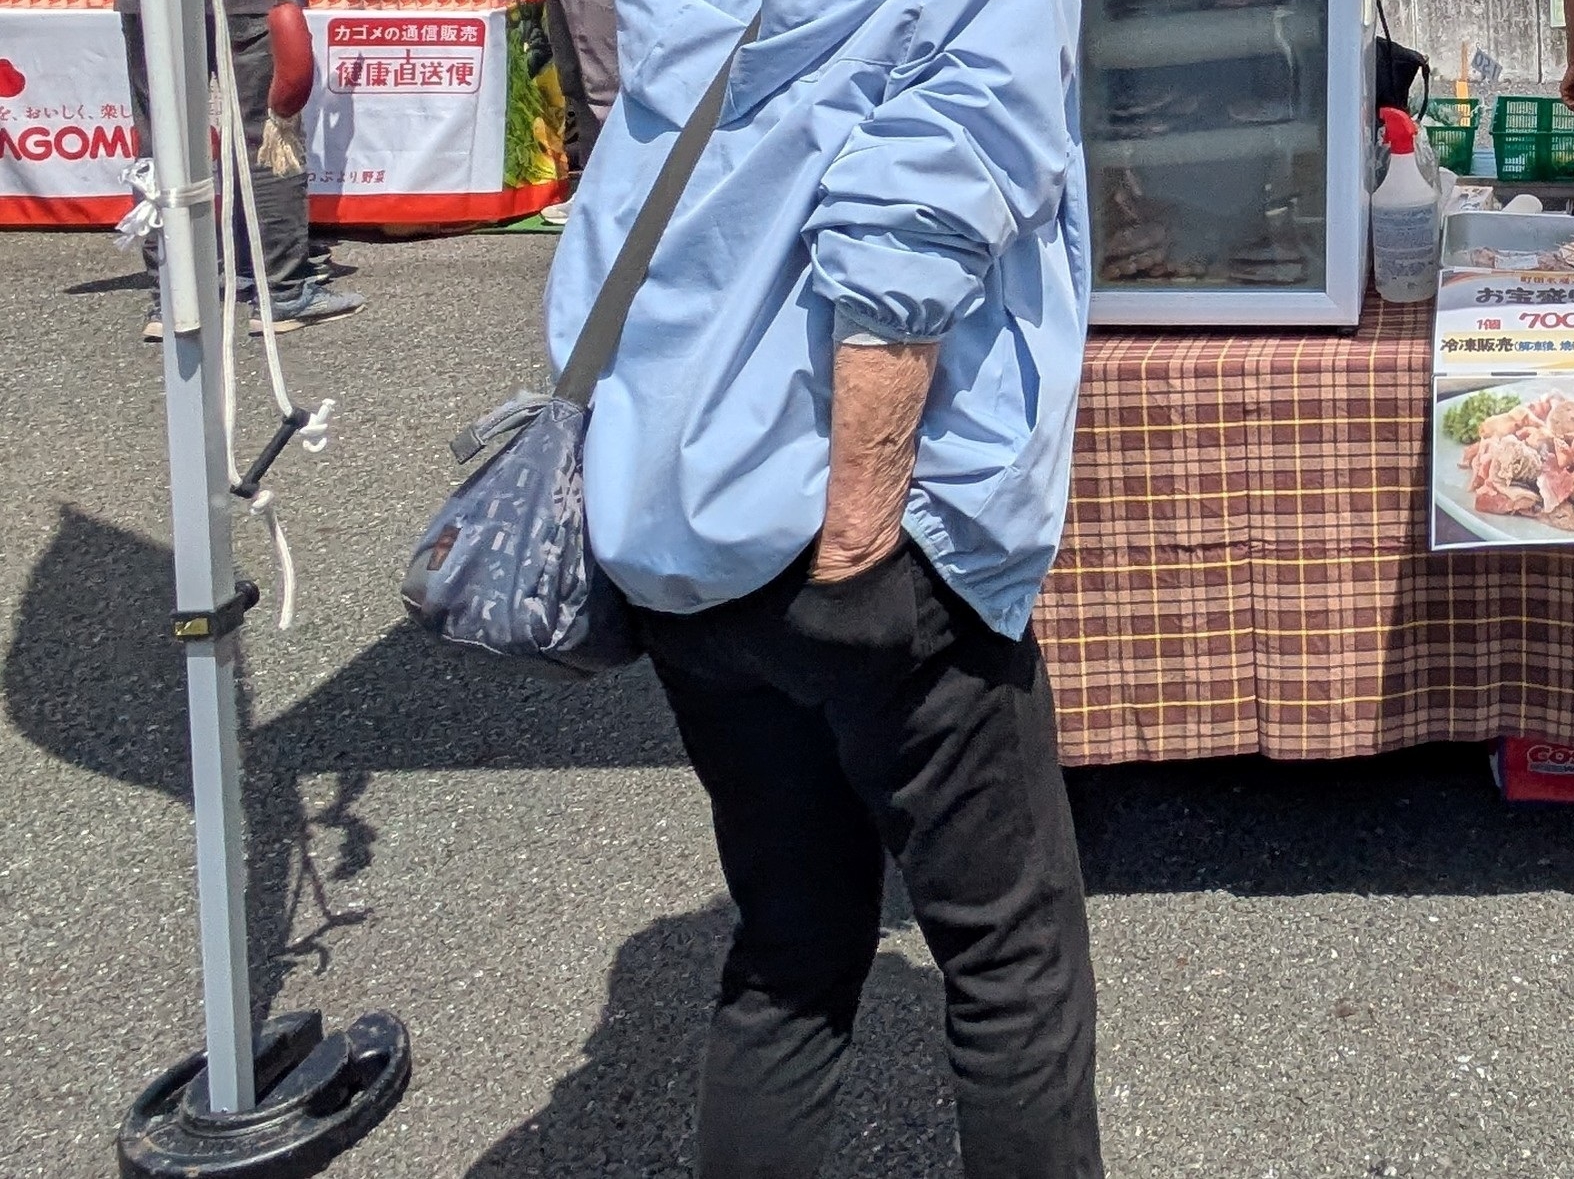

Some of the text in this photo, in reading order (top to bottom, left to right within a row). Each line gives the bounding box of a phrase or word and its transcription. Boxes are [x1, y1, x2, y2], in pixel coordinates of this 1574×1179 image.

[334, 24, 478, 43] カゴメの通信販売
[334, 50, 475, 88] 健康直送便
[0, 125, 139, 162] AGOM
[1476, 317, 1501, 331] 1個
